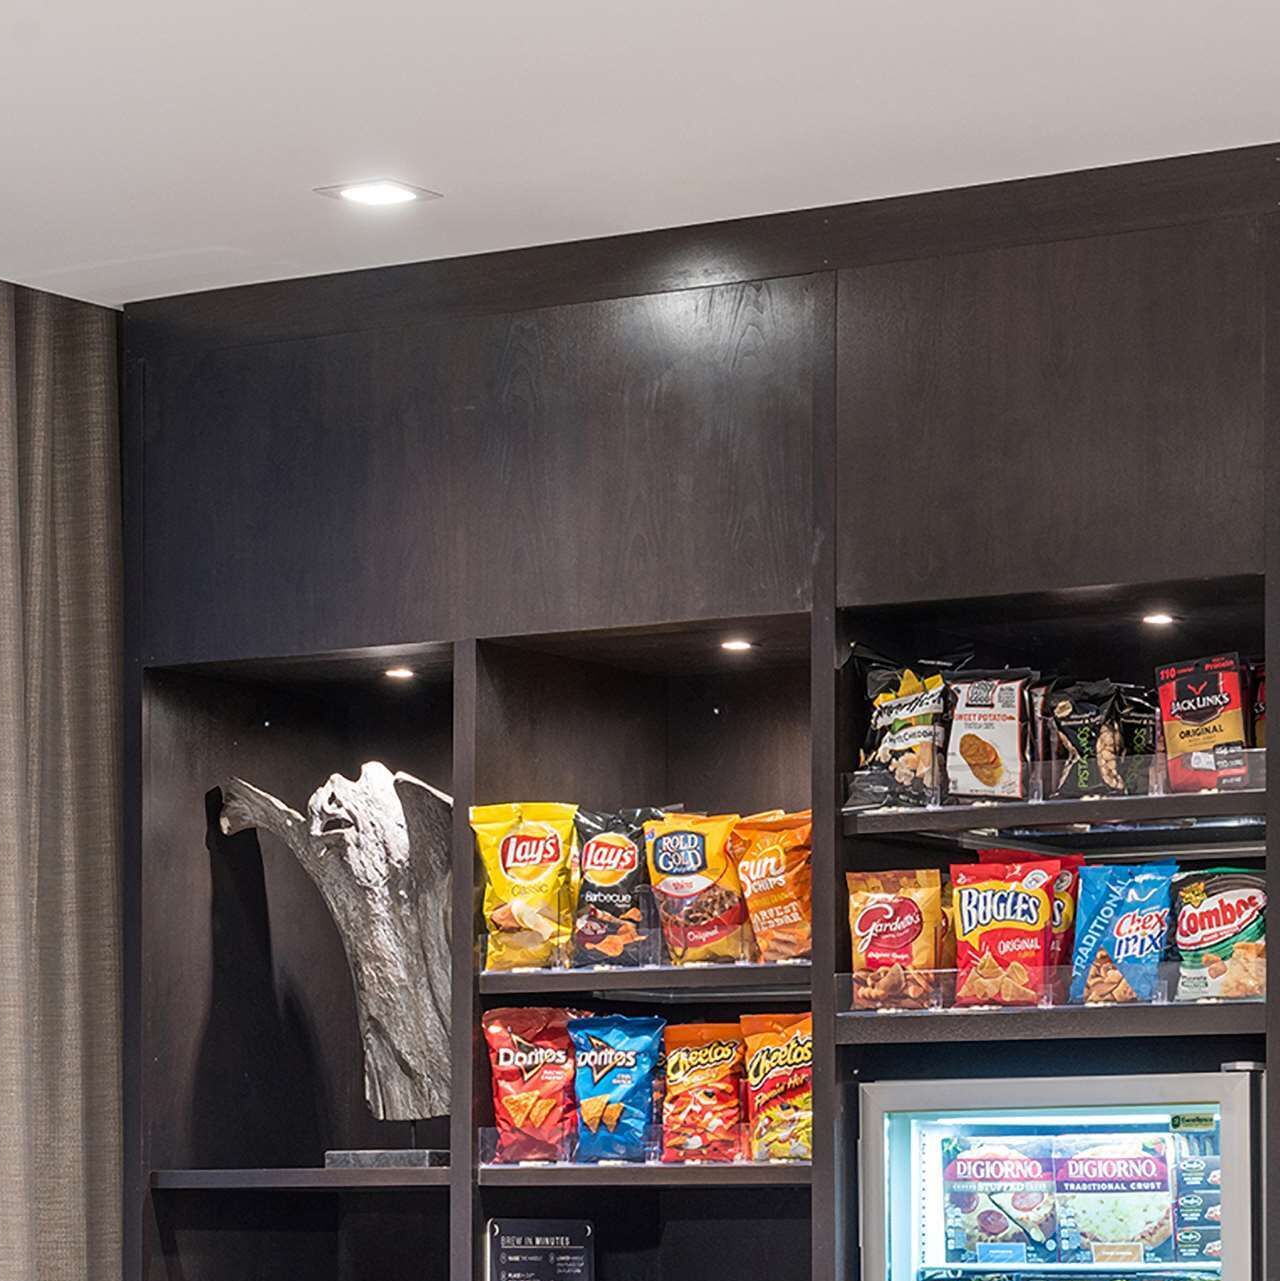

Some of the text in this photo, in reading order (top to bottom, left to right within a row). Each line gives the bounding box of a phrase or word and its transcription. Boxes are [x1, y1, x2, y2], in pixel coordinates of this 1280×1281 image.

[1179, 725, 1224, 740] ORIGINAL
[505, 834, 558, 868] Lay's
[662, 834, 699, 852] ROLD
[585, 842, 634, 870] Lay's
[658, 850, 702, 871] GOLD
[960, 888, 1040, 936] BUGLES
[1114, 907, 1170, 937] Chex
[1072, 879, 1132, 978] TRADITIONAL
[998, 937, 1040, 955] ORIGINAL
[498, 1047, 568, 1067] Doritos
[667, 1040, 737, 1083] Cheetos
[748, 1038, 813, 1088] Cheetos
[956, 1159, 1043, 1178] DIGIORNO
[1067, 1158, 1157, 1178] DIGIORNO
[1064, 1181, 1162, 1191] TRADITIONAL CRUST
